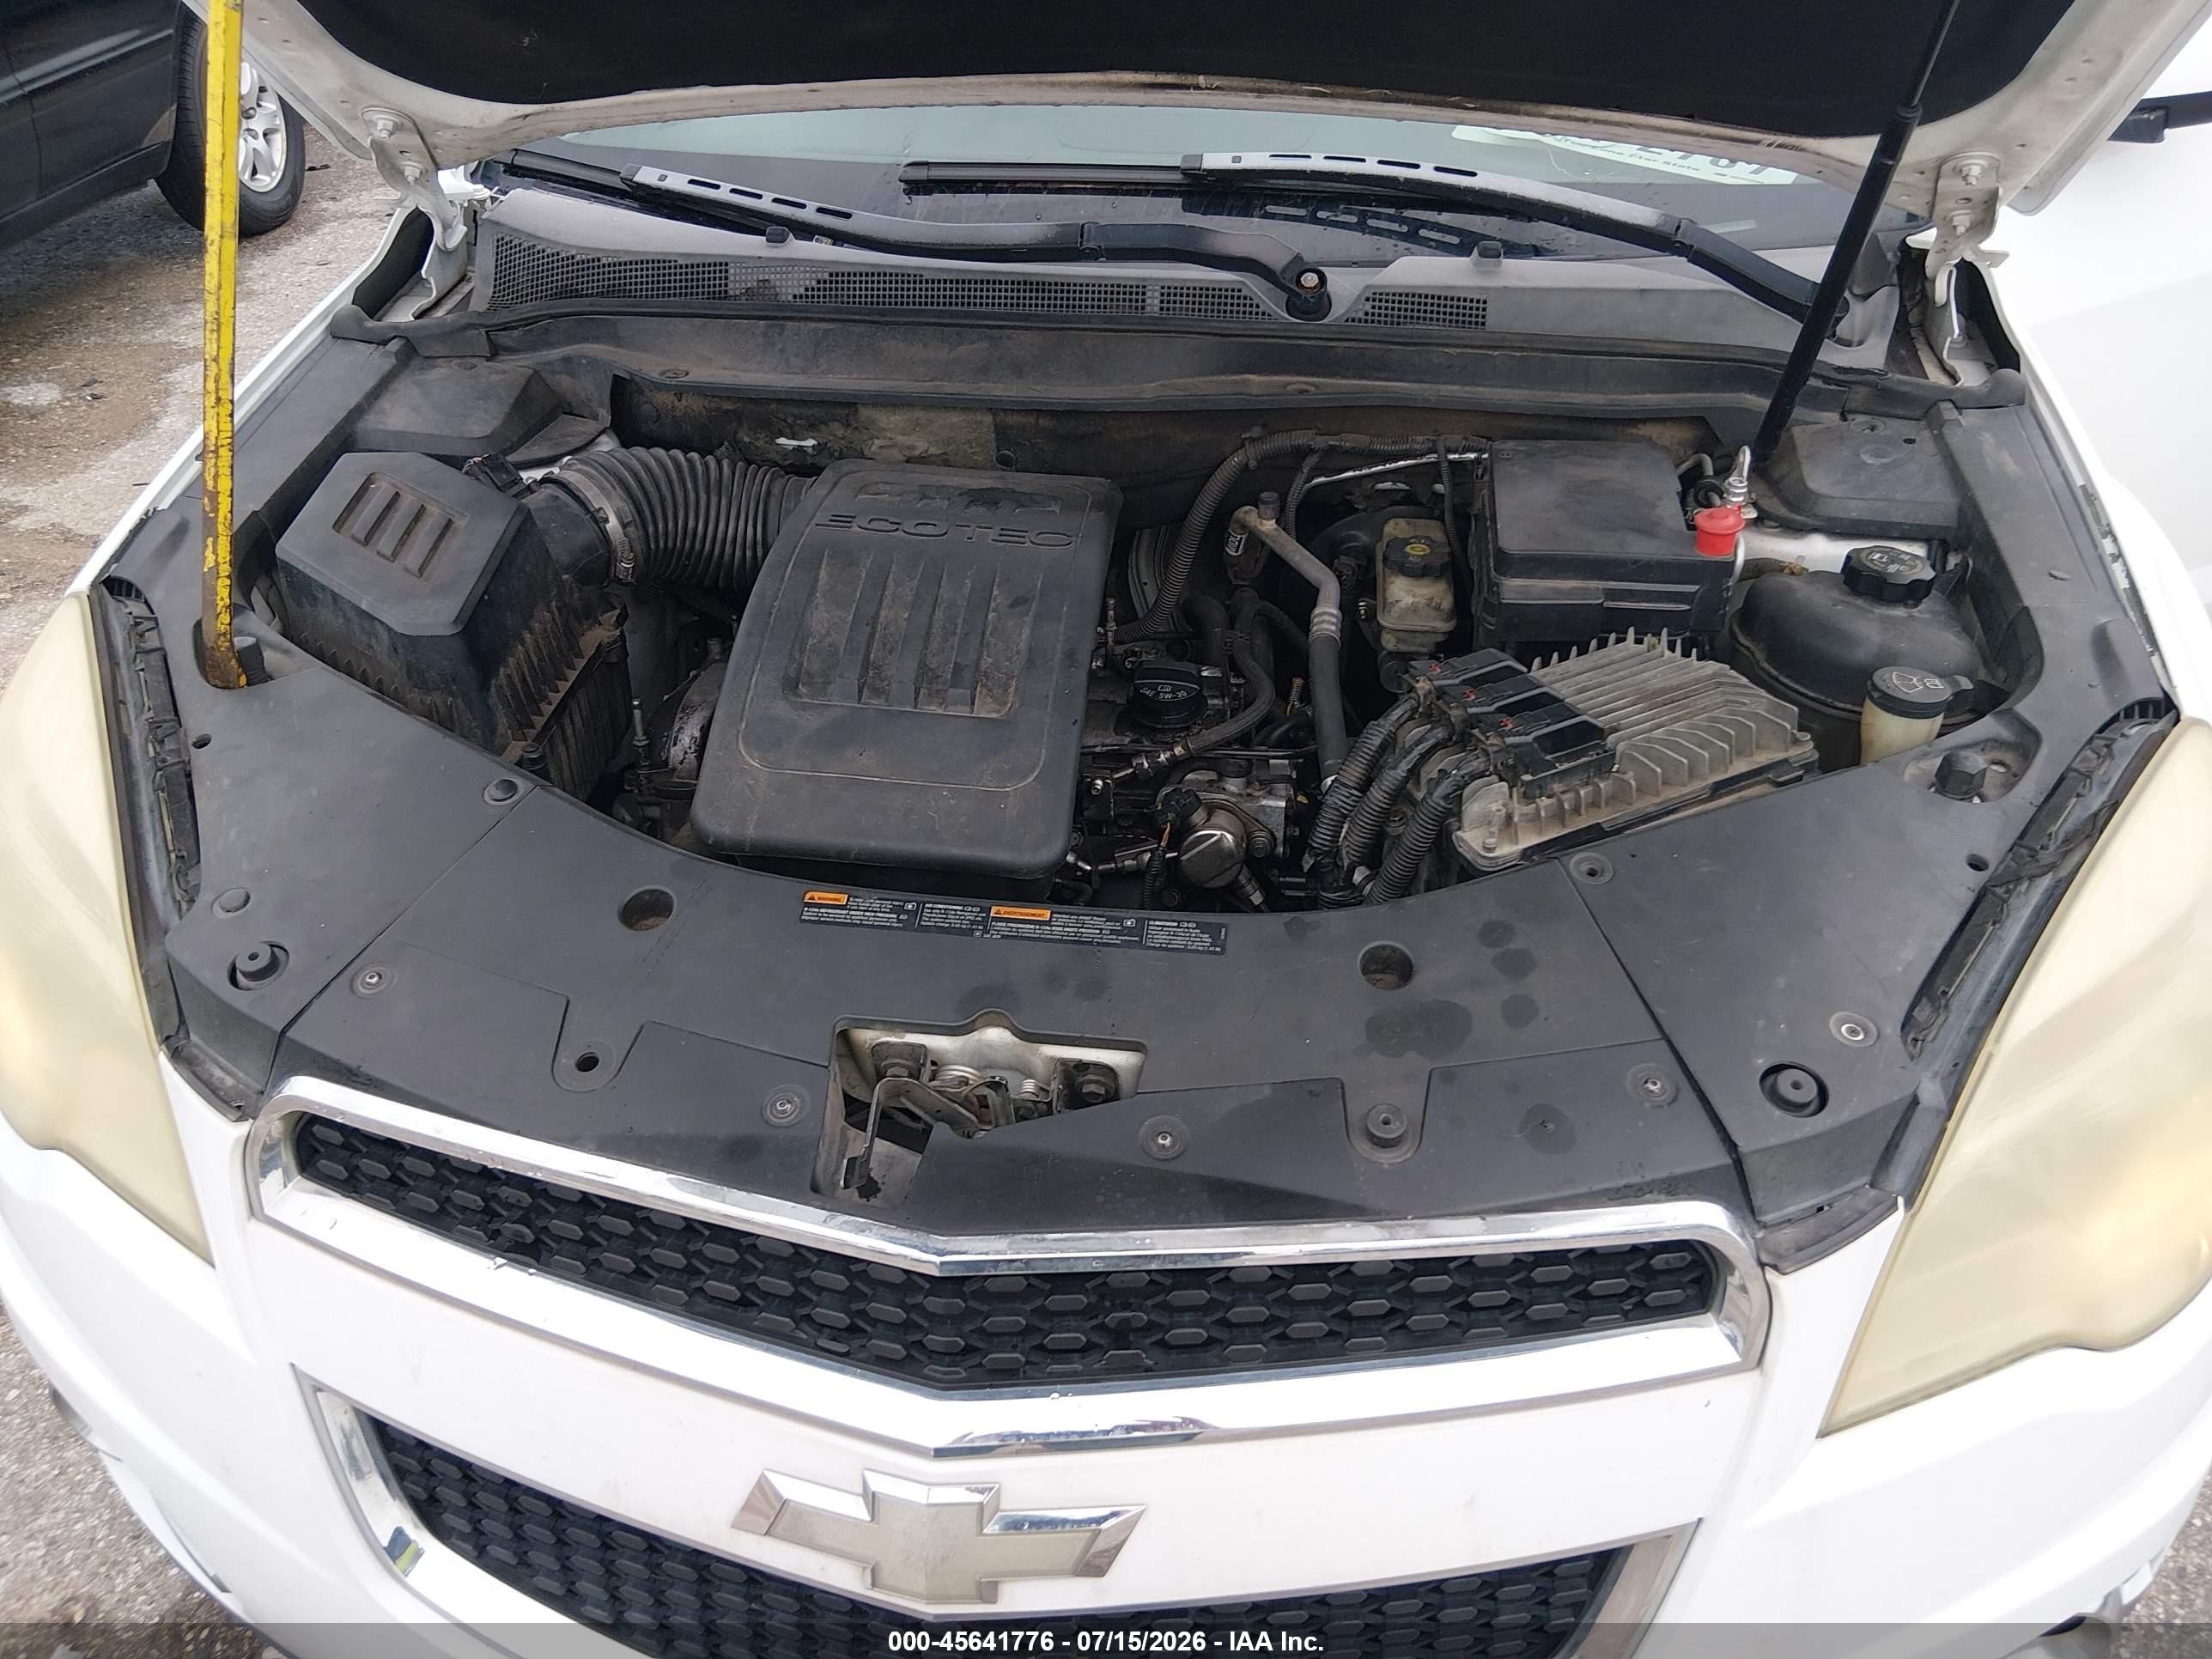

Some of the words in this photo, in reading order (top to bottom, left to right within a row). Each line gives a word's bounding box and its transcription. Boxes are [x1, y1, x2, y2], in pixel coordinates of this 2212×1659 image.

[816, 514, 1073, 548] ECOTEC
[1139, 687, 1157, 697] SAE
[1158, 690, 1188, 699] 5W-30
